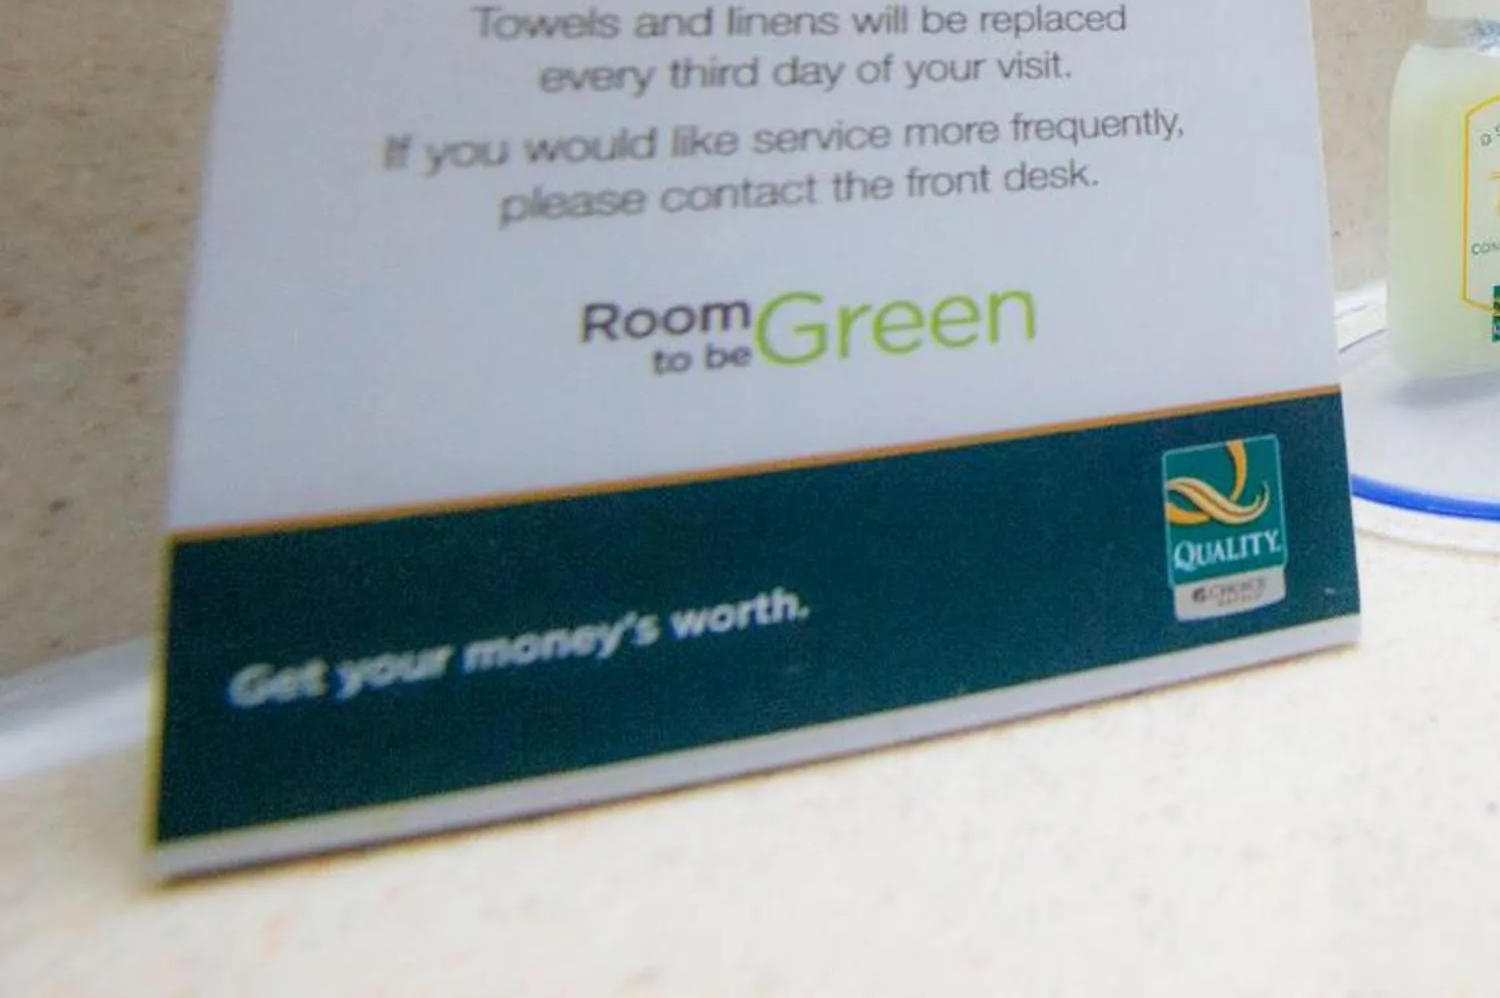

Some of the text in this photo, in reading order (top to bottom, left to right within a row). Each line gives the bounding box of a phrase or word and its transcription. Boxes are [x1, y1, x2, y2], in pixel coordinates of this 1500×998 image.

[472, 3, 1127, 40] Towels and linens will be replaced
[538, 50, 1072, 99] every third day of your visit.
[383, 107, 1184, 178] If you would like service more frequently,
[499, 158, 1099, 230] please contact the front desk.
[581, 299, 751, 343] Room
[754, 289, 1036, 366] Green
[652, 342, 752, 375] to be
[1174, 529, 1279, 572] QUALITY
[227, 587, 811, 708] Get your money's worth.
